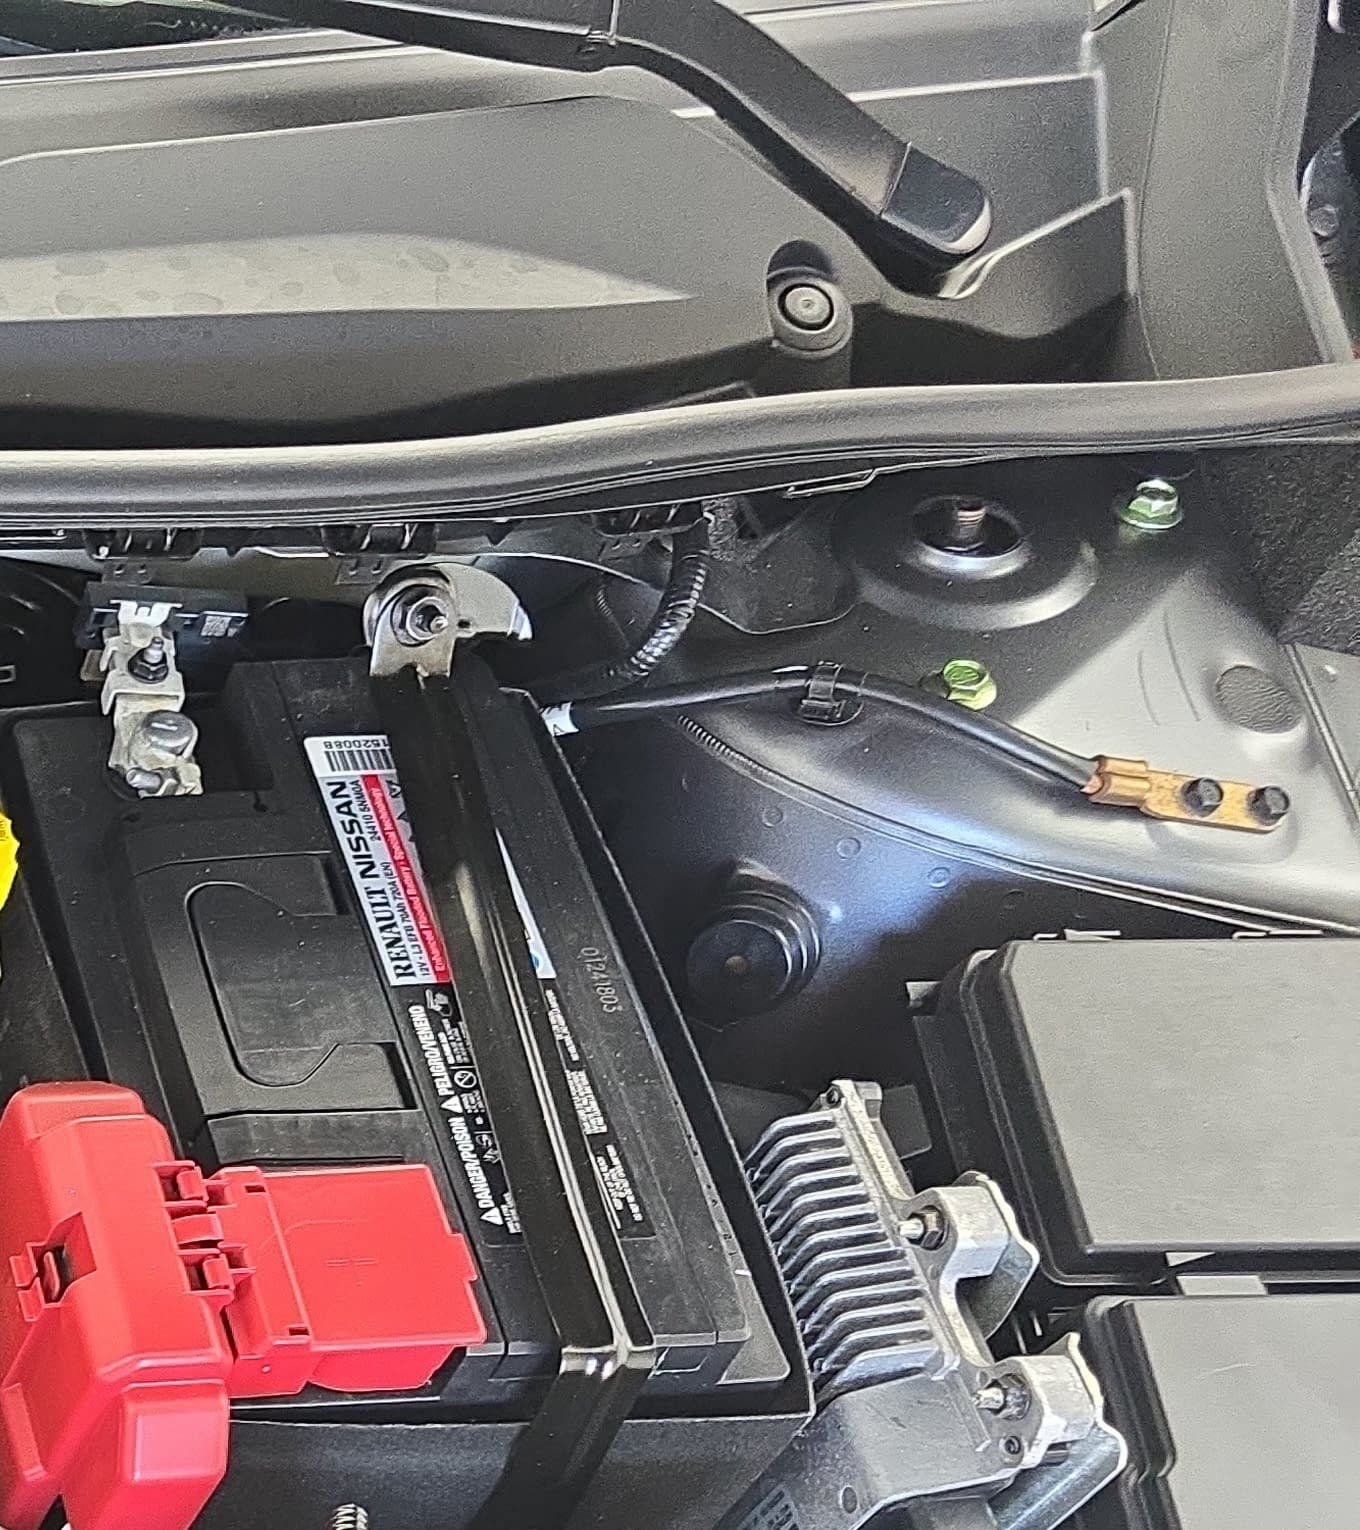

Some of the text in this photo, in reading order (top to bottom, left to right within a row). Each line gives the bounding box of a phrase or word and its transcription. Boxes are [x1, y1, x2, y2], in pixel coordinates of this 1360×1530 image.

[327, 781, 417, 980] RENAULT NISSAN
[408, 1004, 456, 1098] PELIGRO/VENENO
[448, 1116, 496, 1209] DANGER/POISON
